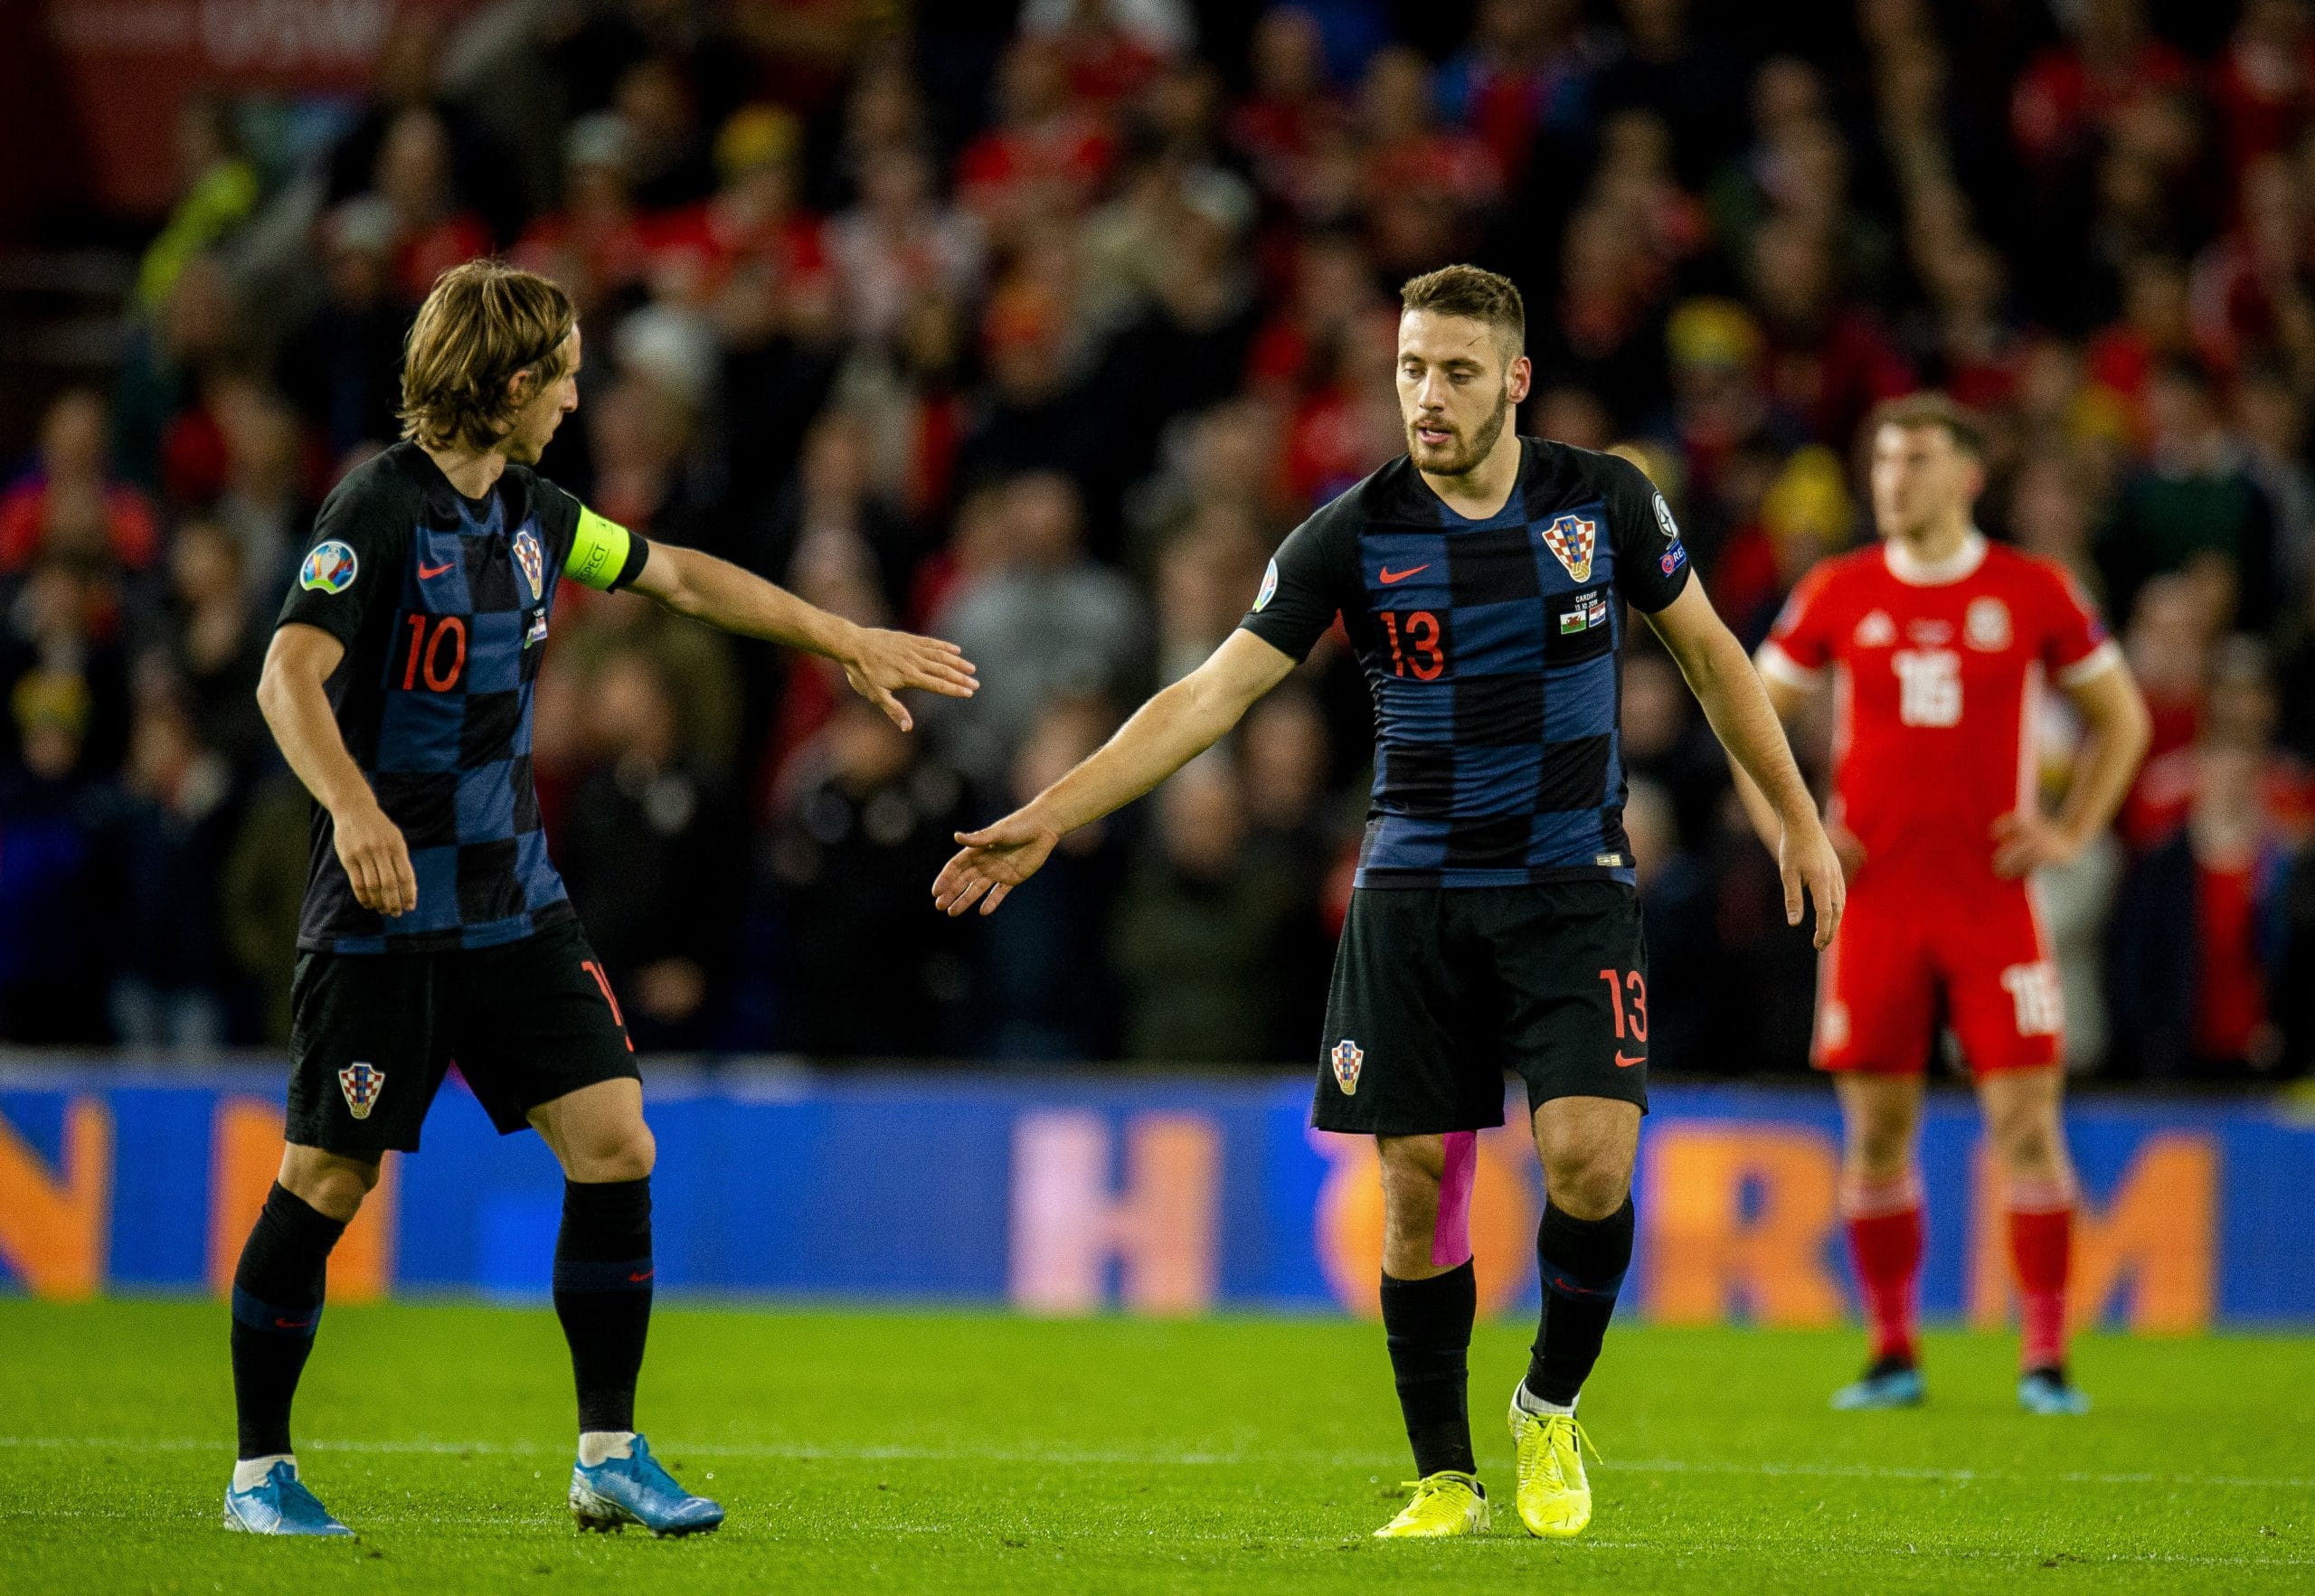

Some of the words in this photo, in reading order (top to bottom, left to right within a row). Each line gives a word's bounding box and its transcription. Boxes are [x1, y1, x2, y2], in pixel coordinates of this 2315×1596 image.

[1575, 590, 1598, 603] CARDIFF
[404, 615, 466, 692] 10
[1380, 611, 1445, 680] 13
[581, 959, 626, 1027] 1
[1600, 968, 1647, 1043] 13
